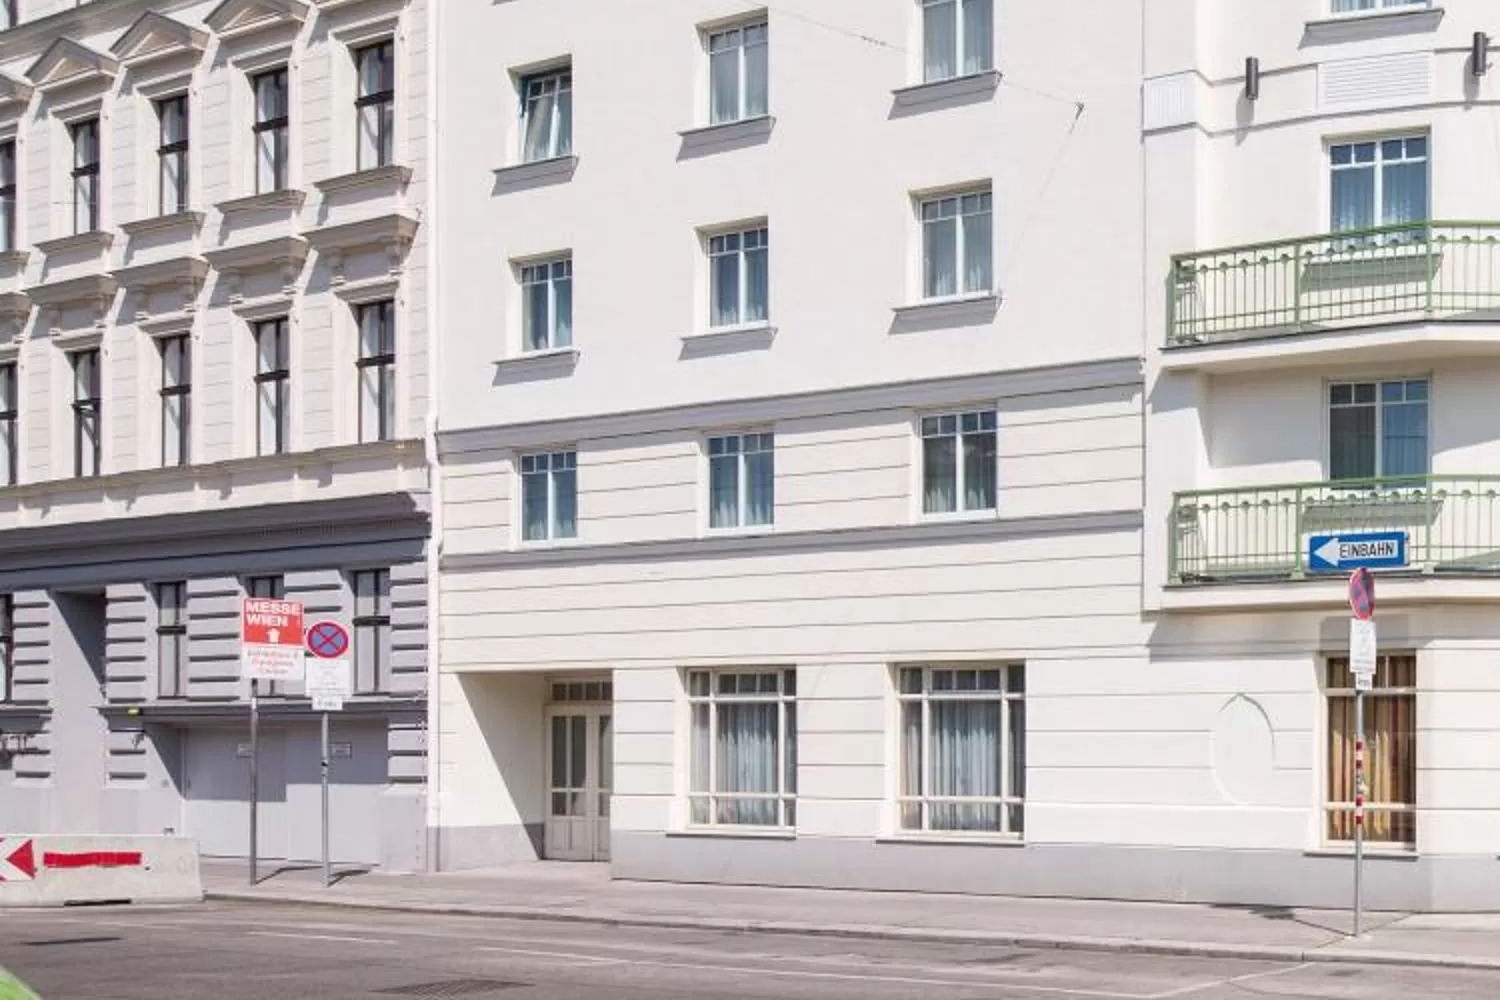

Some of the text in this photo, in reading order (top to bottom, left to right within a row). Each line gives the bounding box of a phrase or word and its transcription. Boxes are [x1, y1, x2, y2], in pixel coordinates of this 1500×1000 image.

[1339, 542, 1395, 559] EINBAHN
[245, 601, 301, 615] MESSE
[246, 614, 289, 627] WIEN
